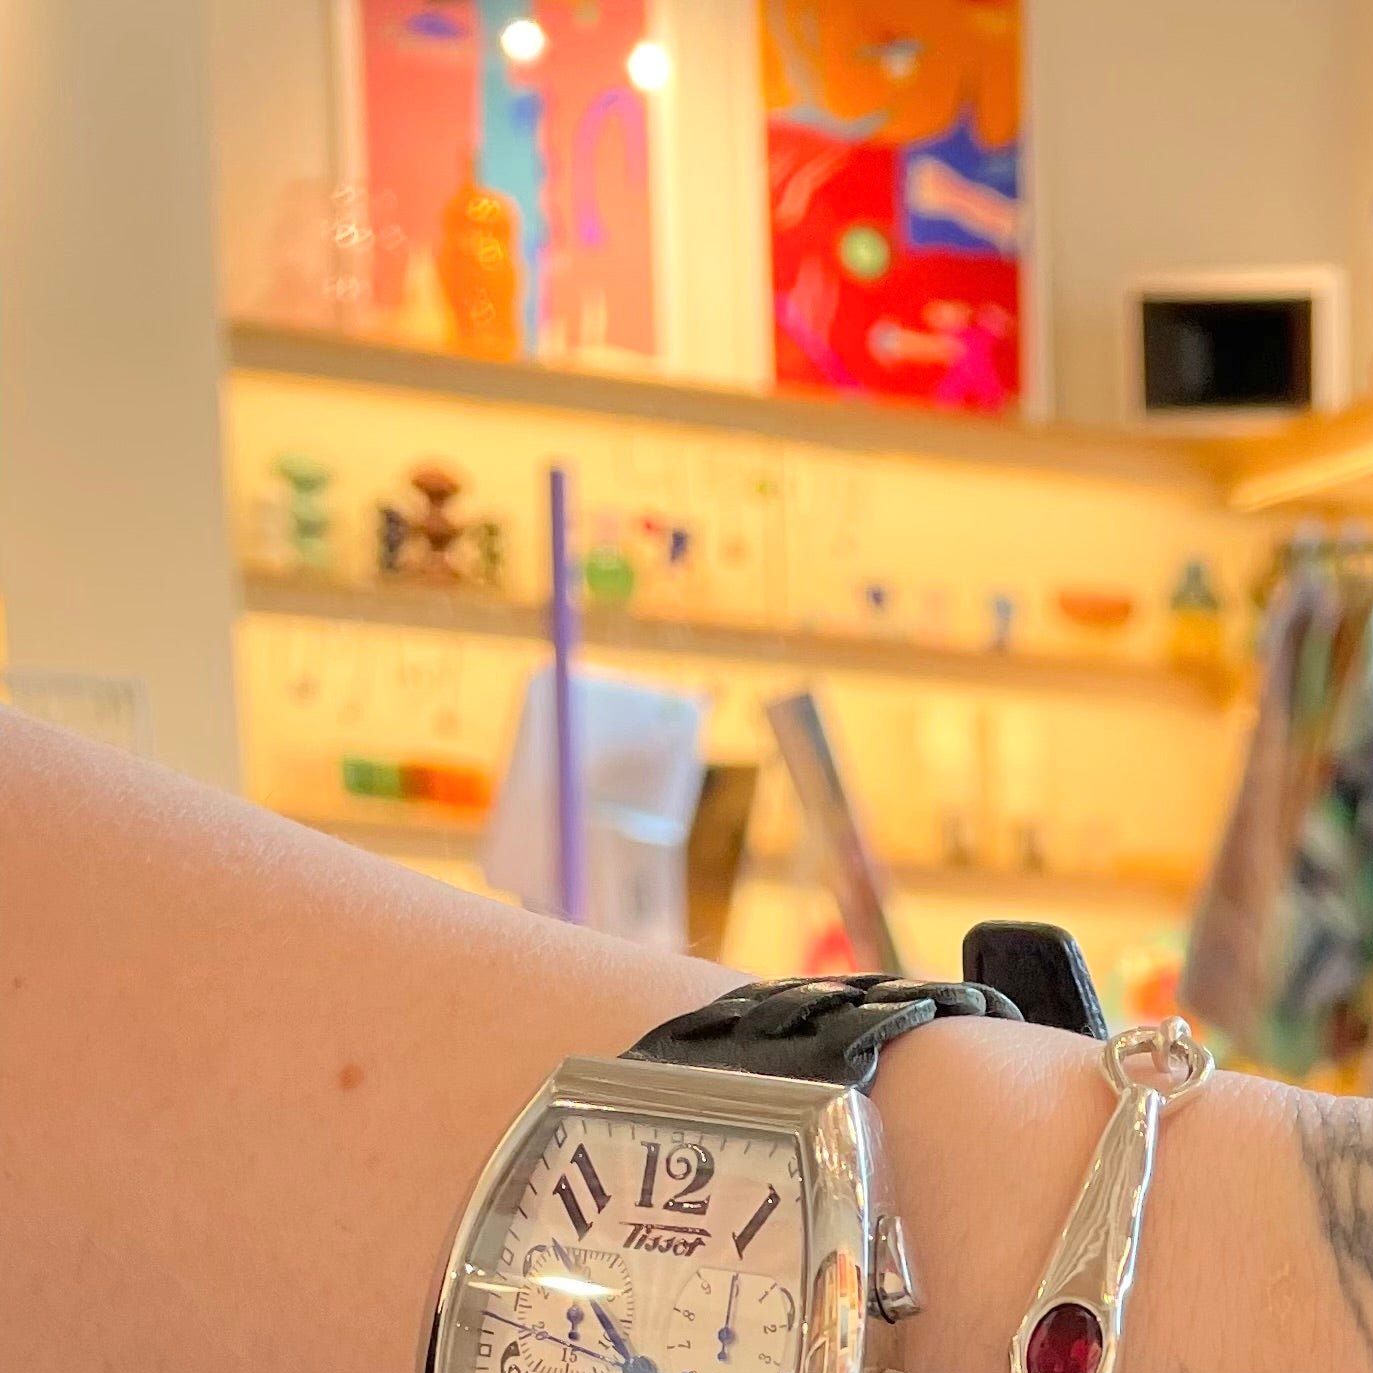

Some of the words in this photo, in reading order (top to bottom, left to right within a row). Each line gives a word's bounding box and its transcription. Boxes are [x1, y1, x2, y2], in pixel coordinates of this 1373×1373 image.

[552, 1142, 612, 1242] 11
[634, 1140, 715, 1216] 12
[618, 1221, 713, 1257] Tissot
[732, 1183, 782, 1261] 1
[561, 1347, 578, 1363] 15
